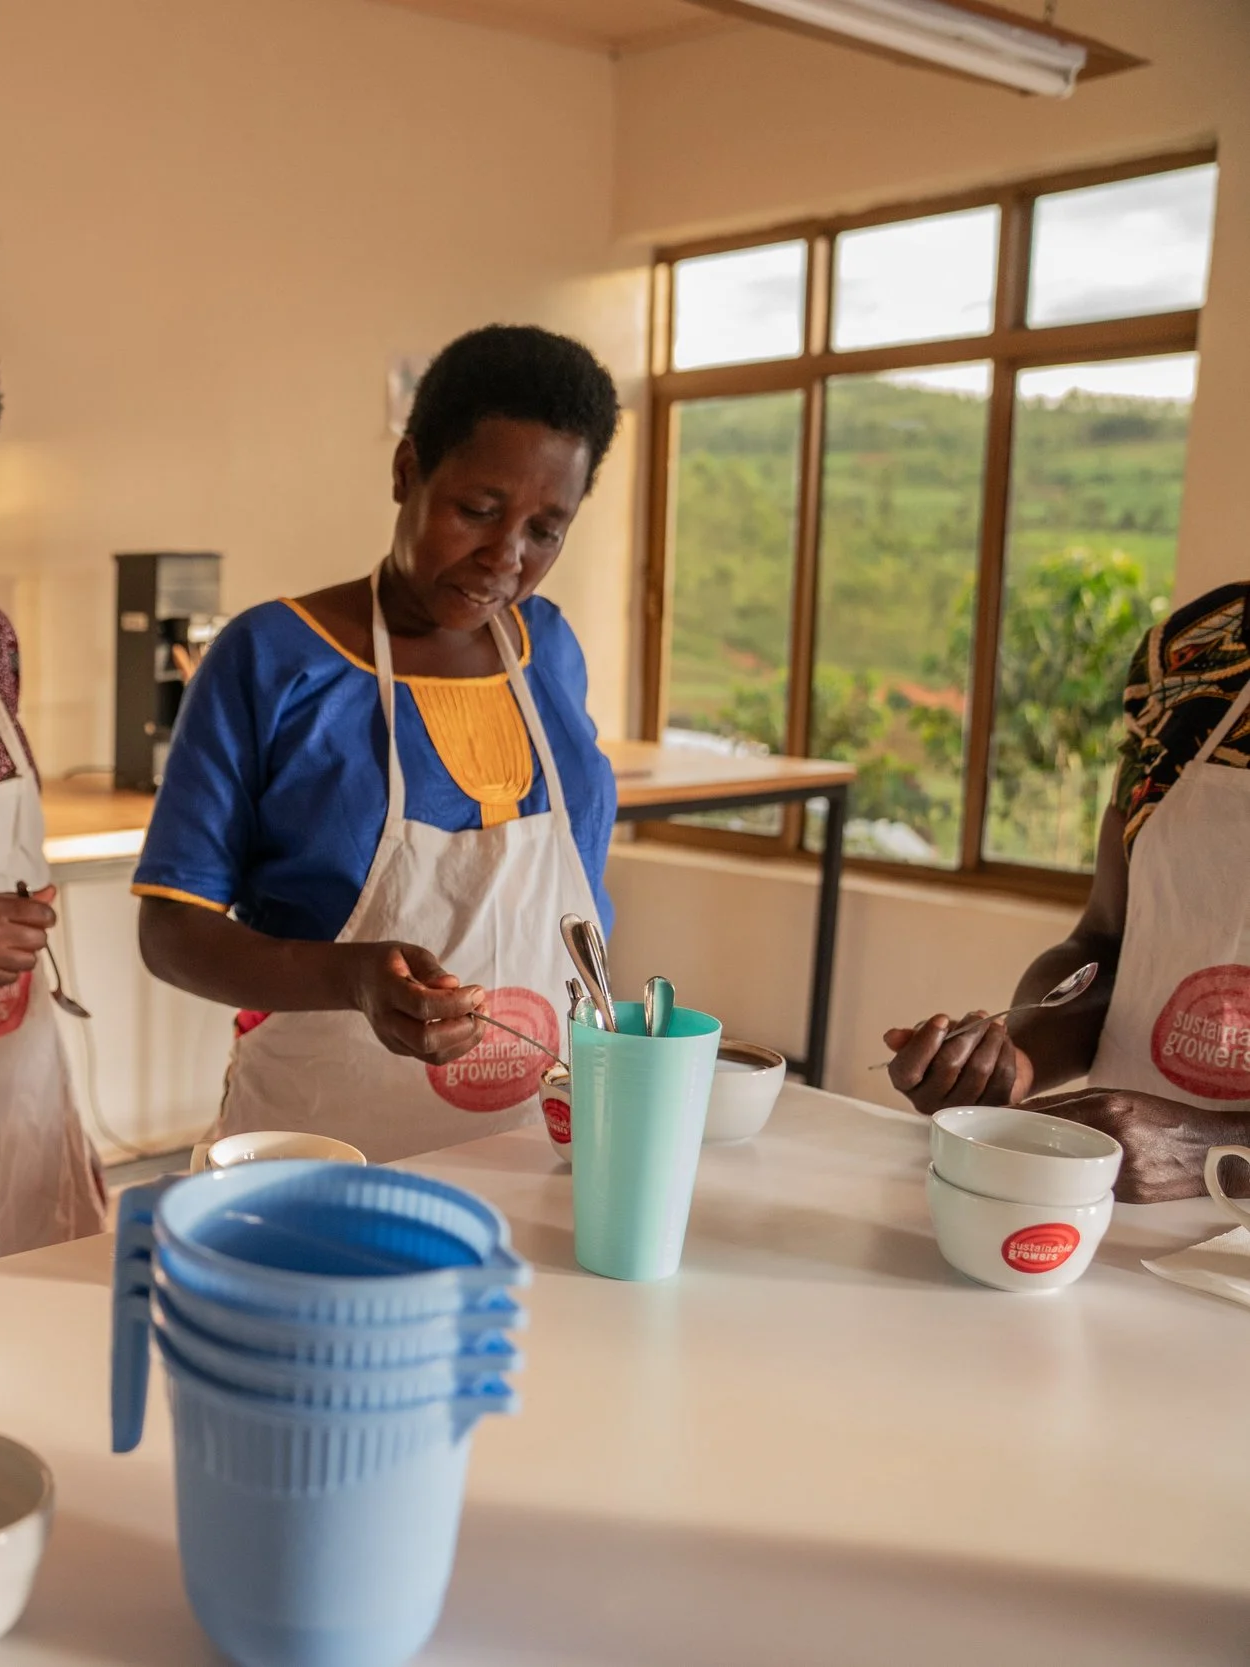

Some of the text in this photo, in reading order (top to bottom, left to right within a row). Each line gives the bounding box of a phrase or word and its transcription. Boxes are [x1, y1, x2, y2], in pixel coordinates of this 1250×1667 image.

[446, 1058, 527, 1087] growers
[1009, 1241, 1073, 1253] sustainable
[1008, 1249, 1058, 1261] growers
